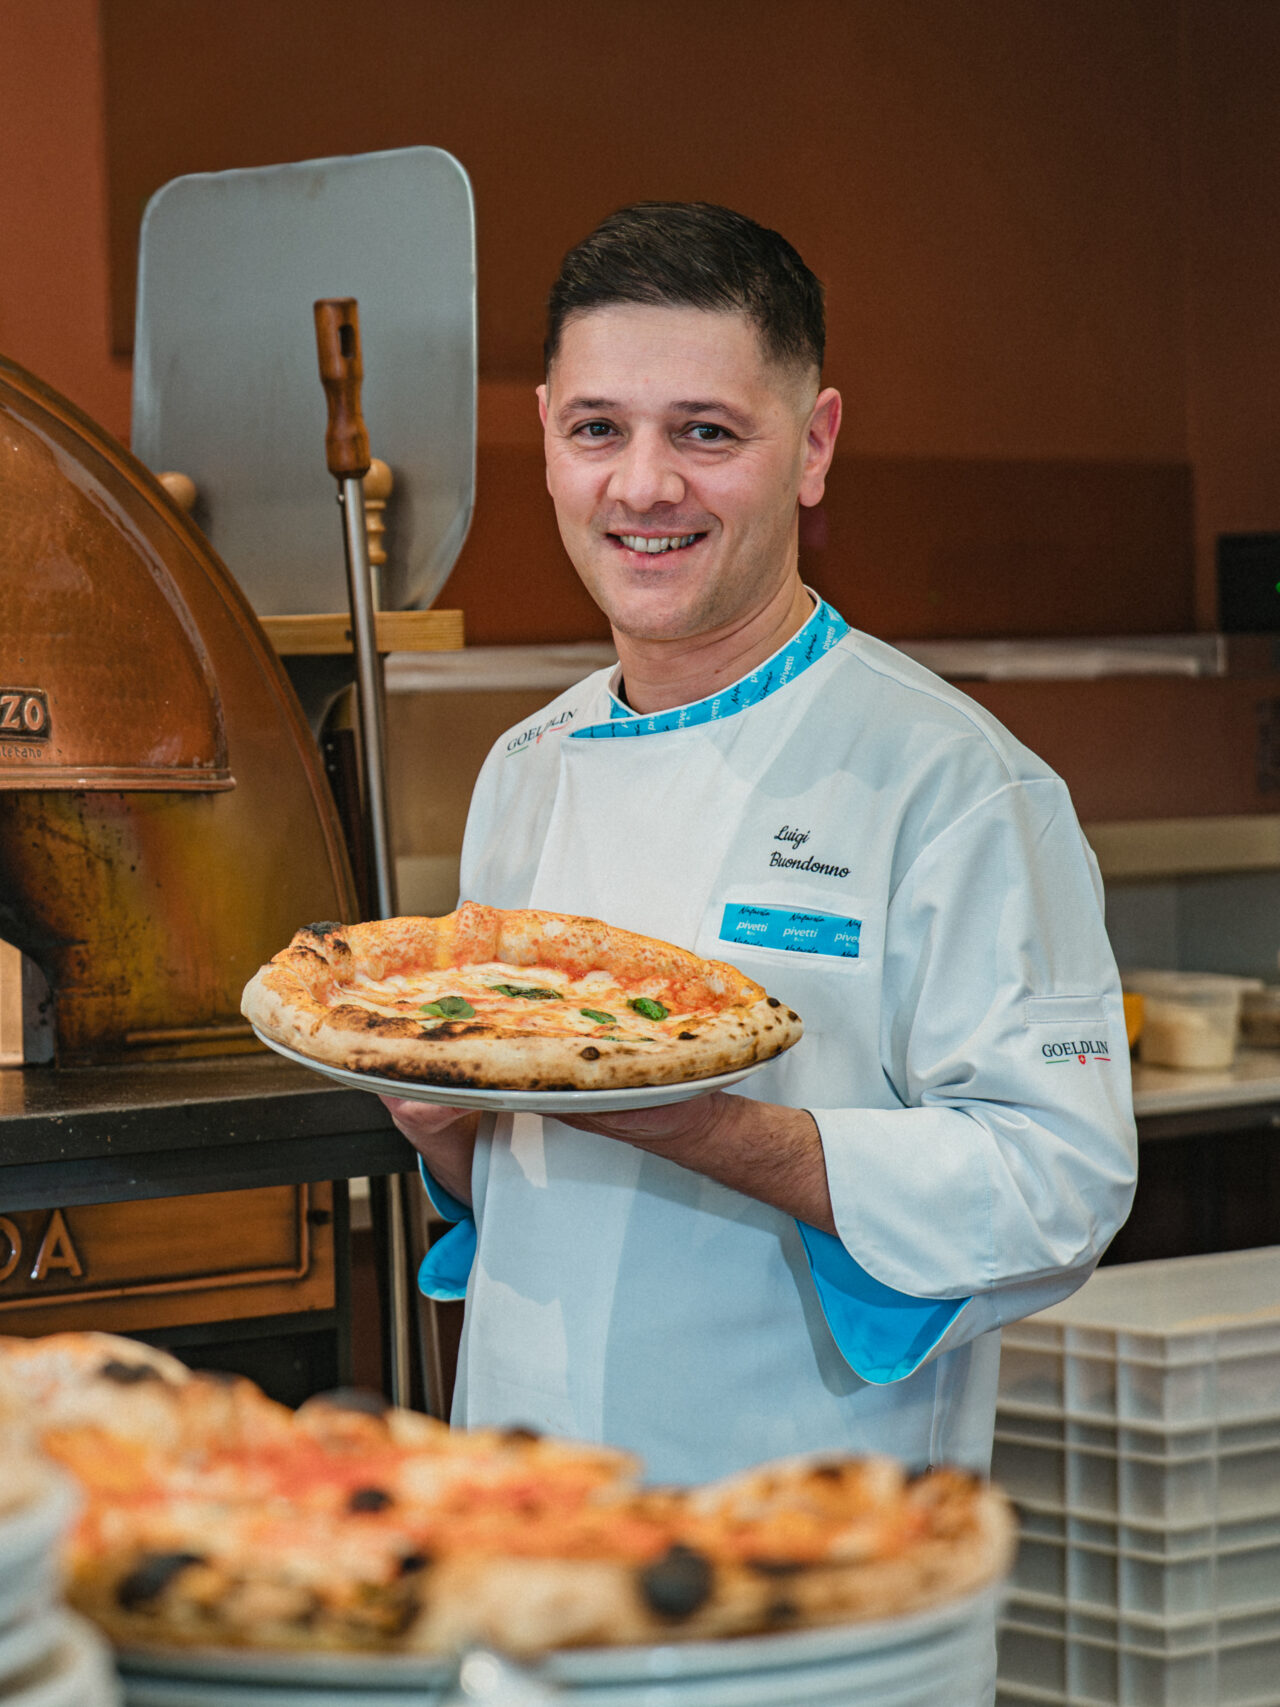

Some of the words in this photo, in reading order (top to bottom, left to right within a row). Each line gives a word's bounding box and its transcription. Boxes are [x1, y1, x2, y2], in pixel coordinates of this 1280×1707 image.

[779, 656, 795, 685] pivetti
[773, 825, 811, 850] Luigi
[769, 851, 851, 878] Buondonno
[735, 920, 769, 933] pivetti
[782, 926, 819, 938] pivetti
[1041, 1040, 1109, 1058] GOELDLIN
